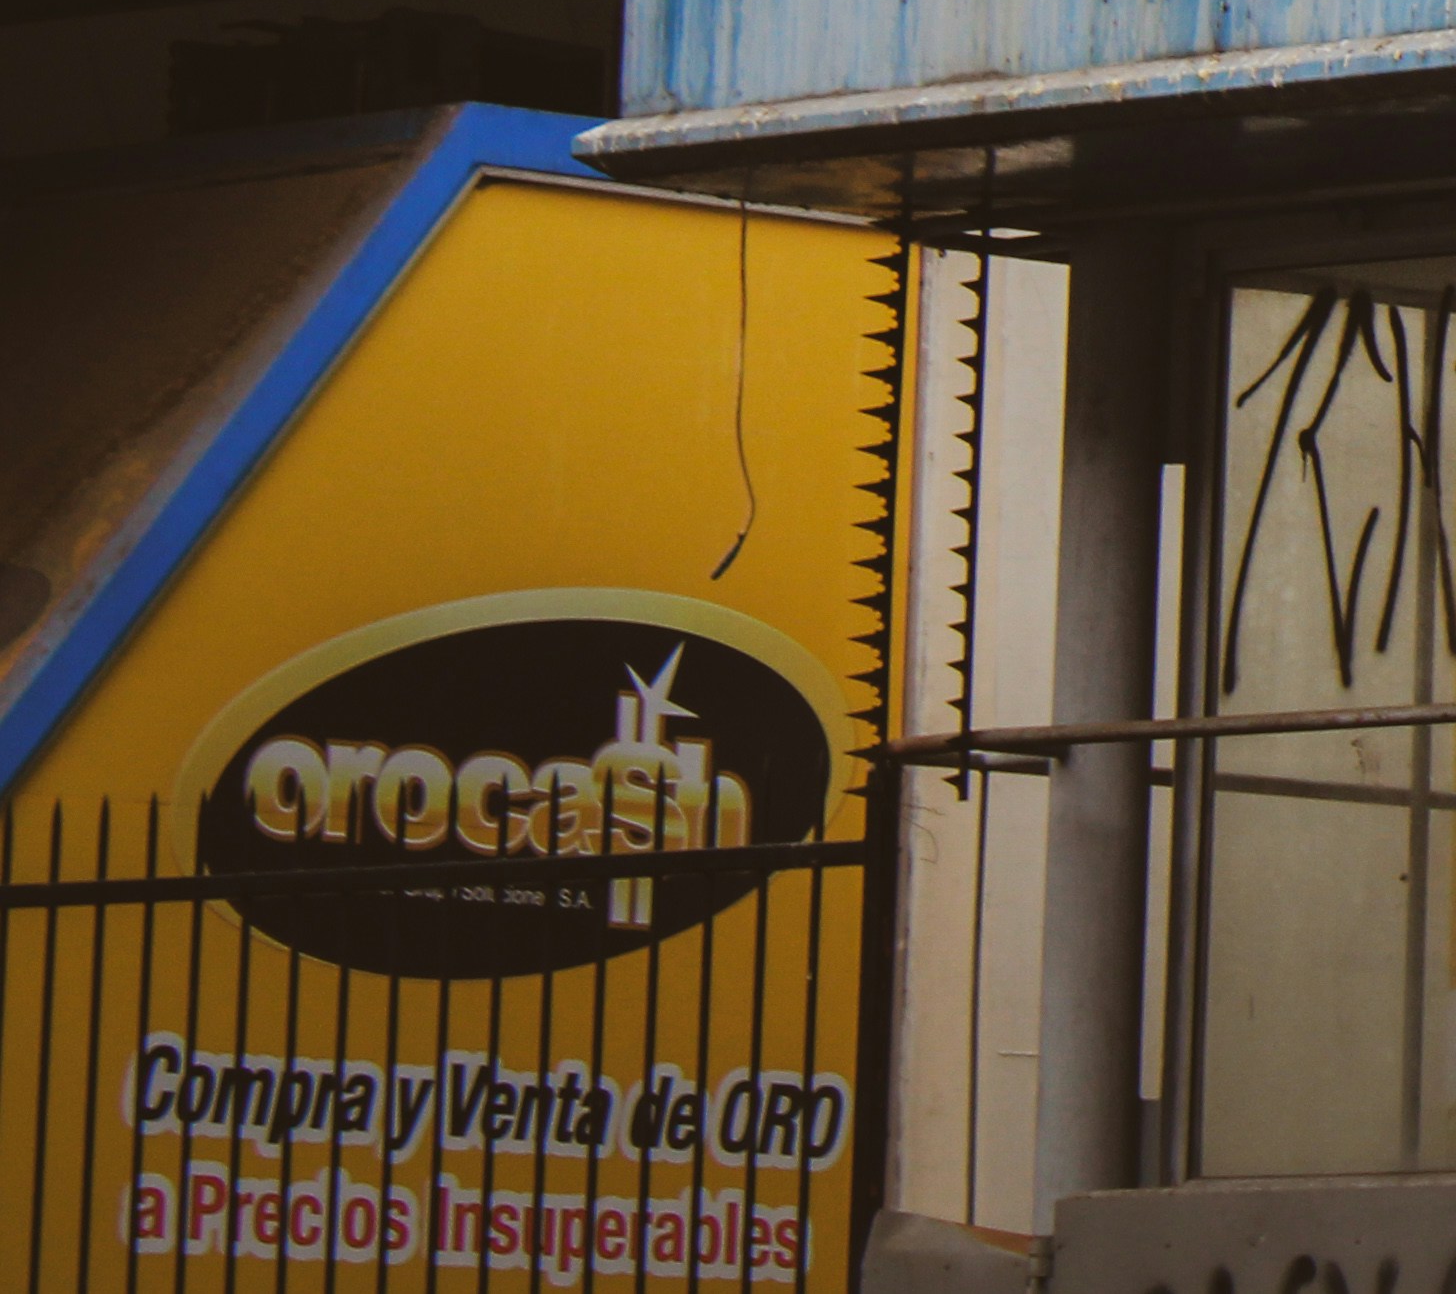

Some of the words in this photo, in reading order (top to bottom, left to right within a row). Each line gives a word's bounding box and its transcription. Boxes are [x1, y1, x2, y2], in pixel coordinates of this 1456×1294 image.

[136, 1043, 378, 1144] Compra
[388, 1076, 434, 1151] y
[448, 1062, 613, 1147] Venta
[630, 1076, 702, 1150] de
[720, 1079, 845, 1159] ORO
[133, 1186, 167, 1240] a
[188, 1174, 411, 1252] Precos
